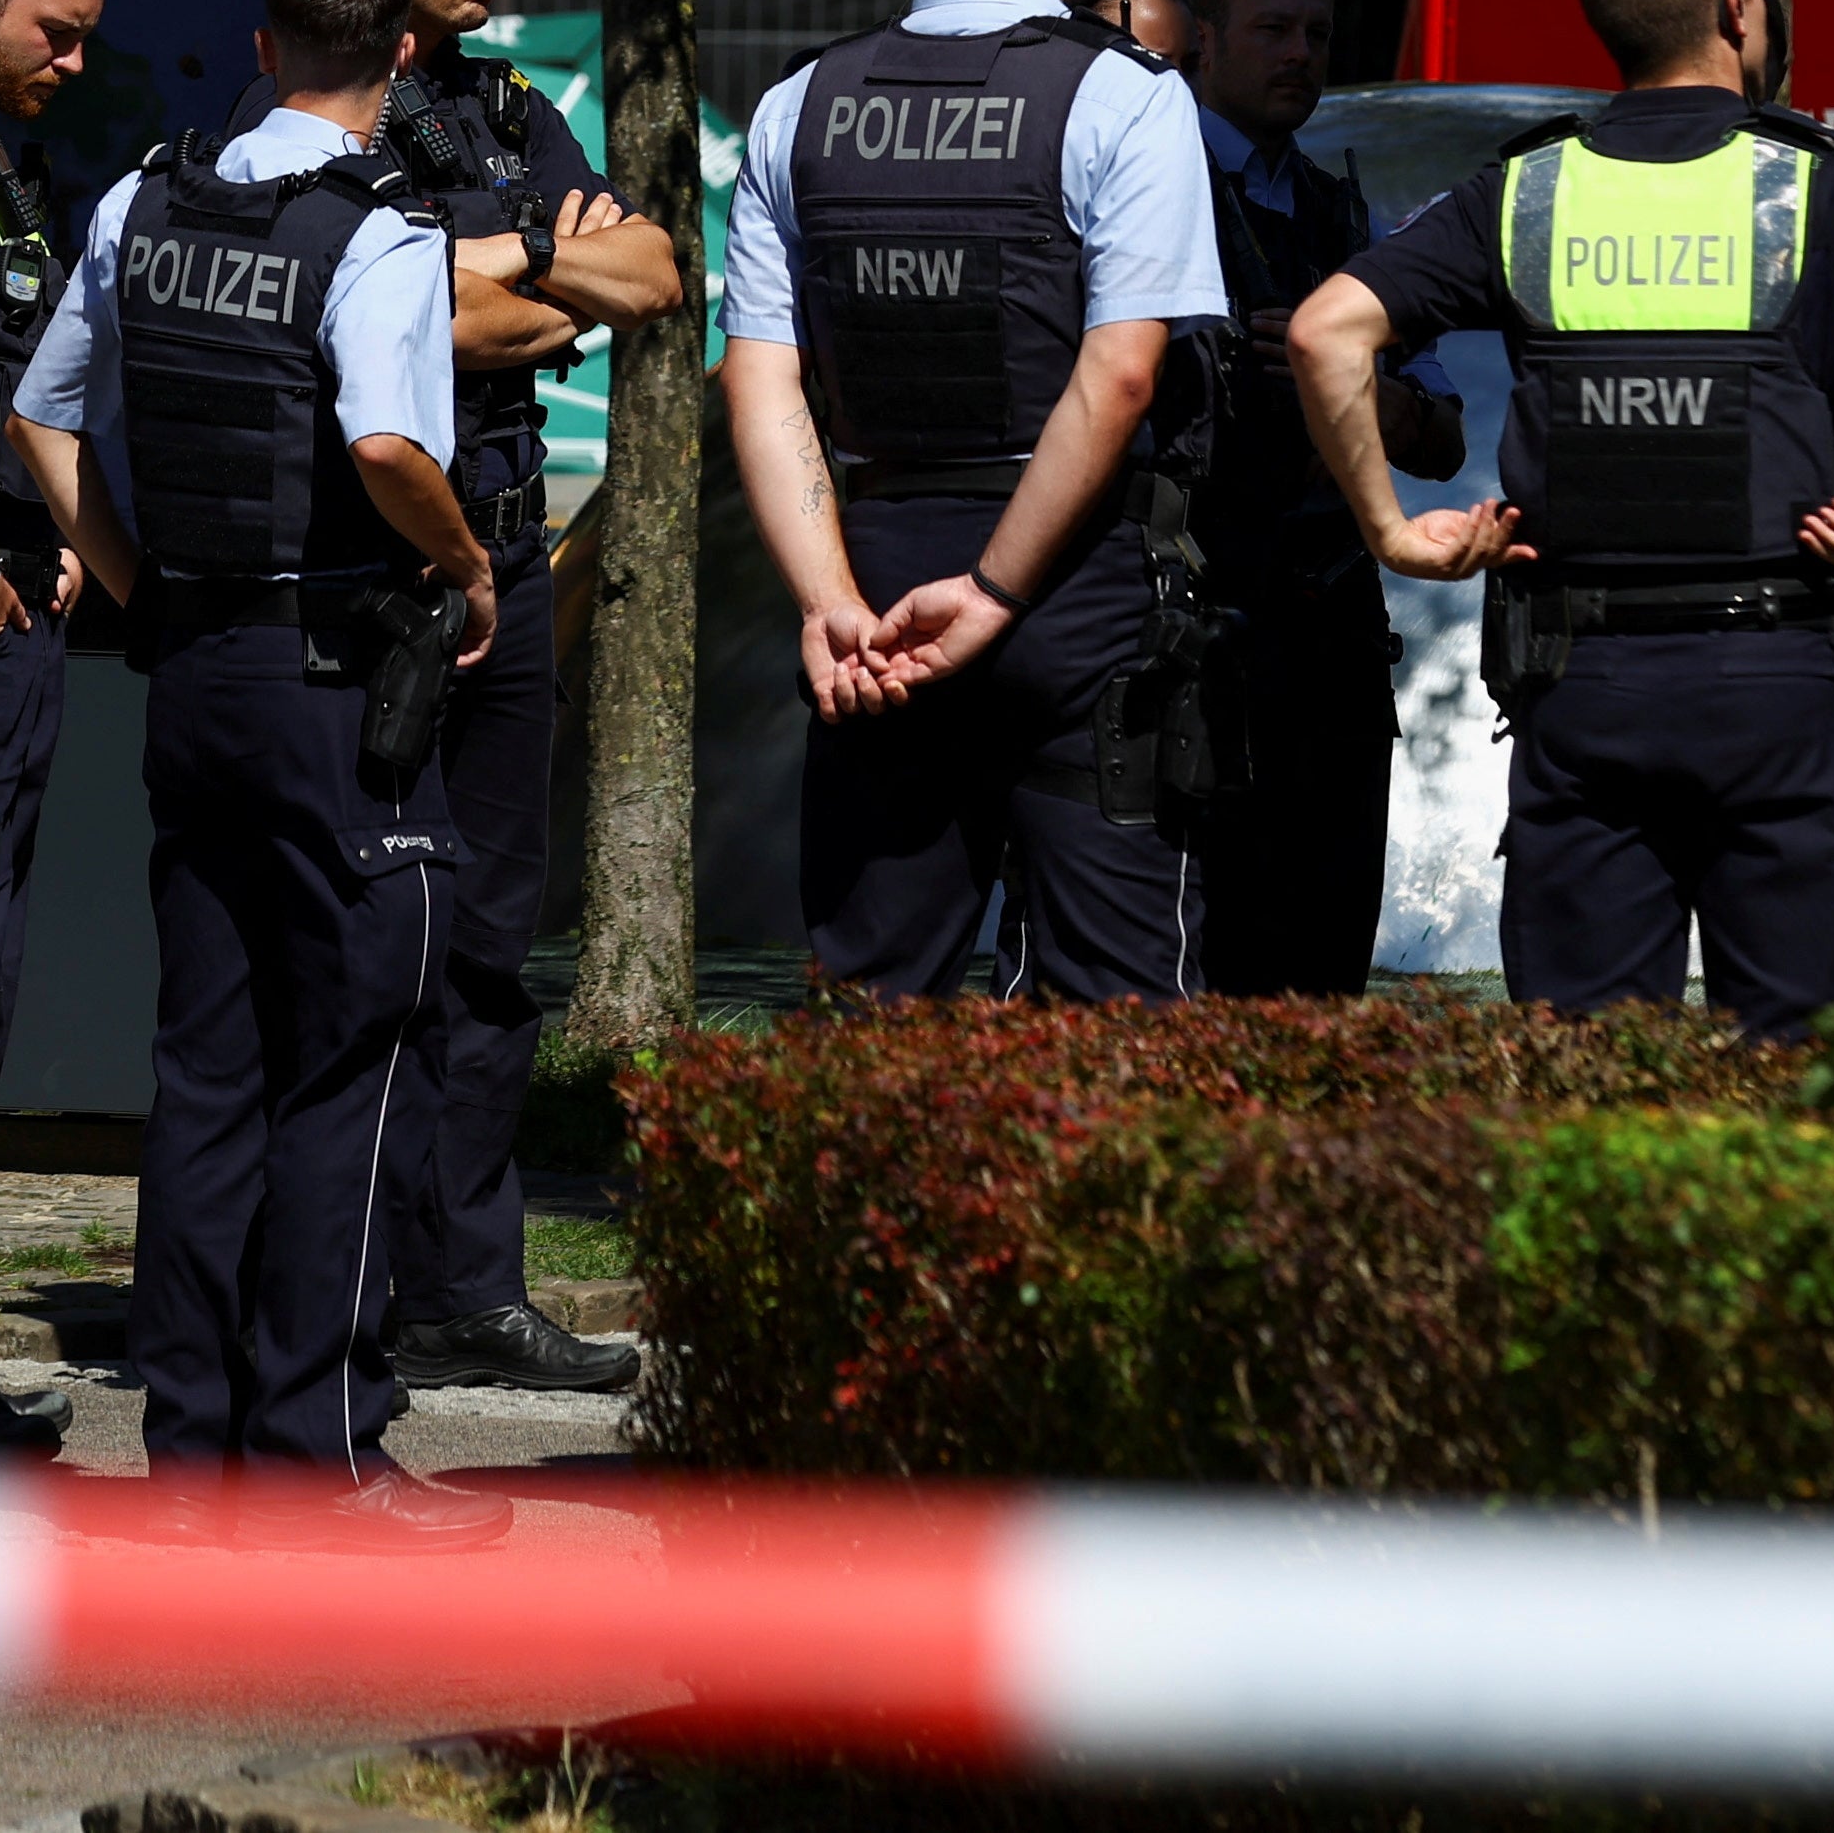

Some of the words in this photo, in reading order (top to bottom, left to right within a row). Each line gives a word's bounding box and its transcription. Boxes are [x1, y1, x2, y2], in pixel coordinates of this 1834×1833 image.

[822, 95, 1026, 161] POLIZEI
[123, 234, 301, 325] POLIZEI
[855, 246, 965, 297] NRW
[1566, 234, 1735, 288] POLIZEI
[1580, 376, 1714, 427] NRW
